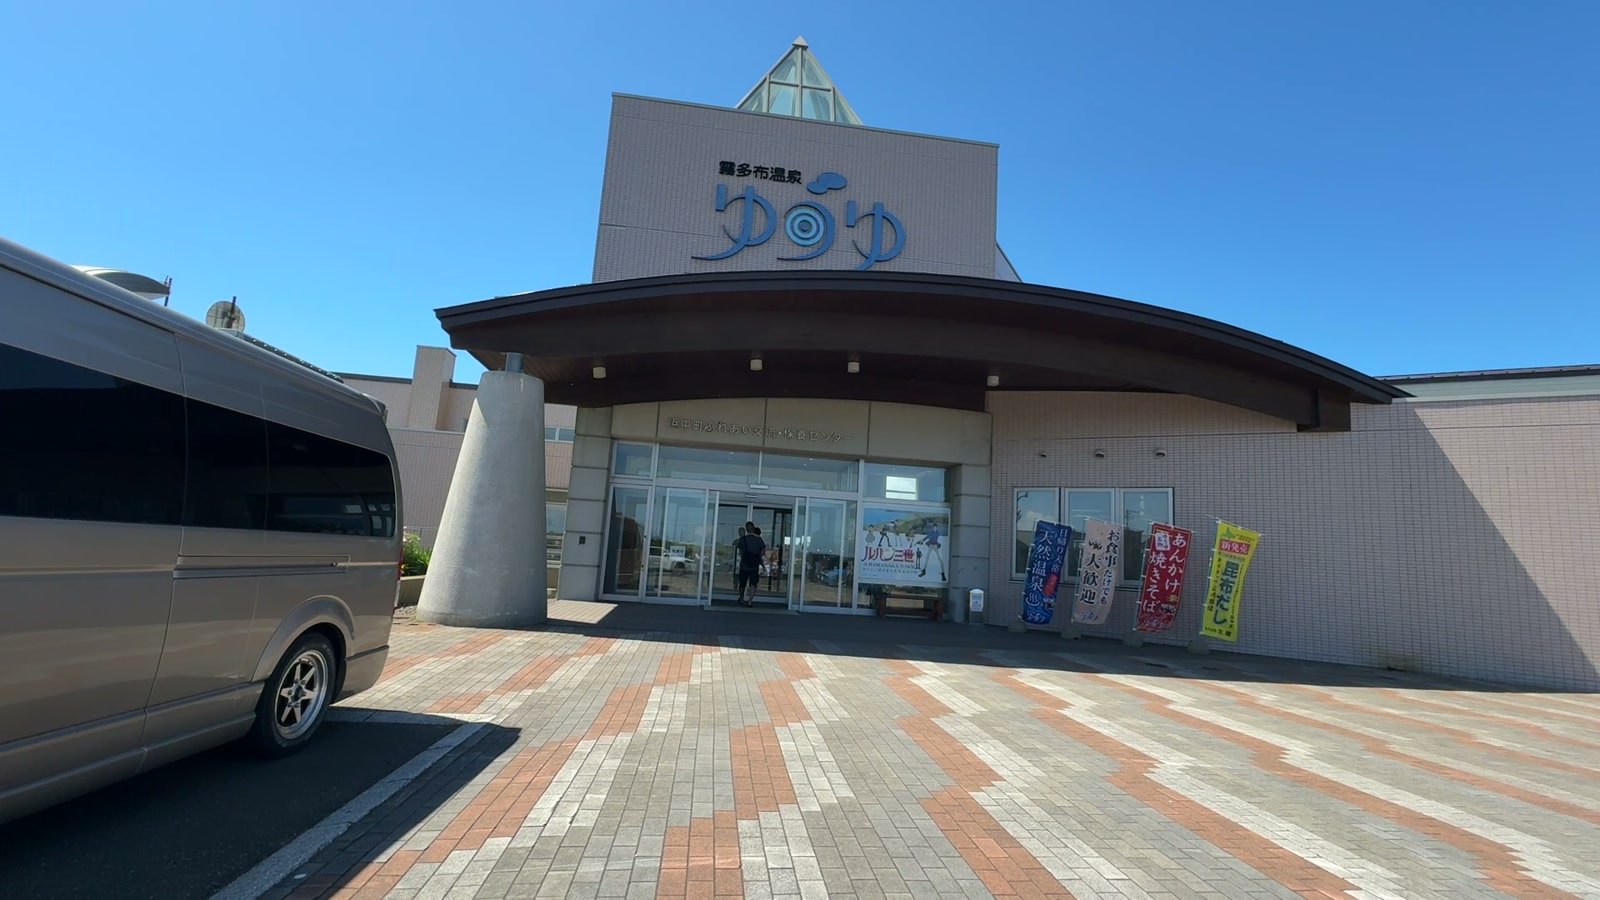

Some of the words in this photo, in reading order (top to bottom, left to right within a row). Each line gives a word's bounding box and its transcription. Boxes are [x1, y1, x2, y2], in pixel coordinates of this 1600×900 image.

[718, 160, 803, 185] 霧多布温泉
[861, 545, 915, 563] ルパン三世
[1030, 529, 1053, 592] 天然温泉
[1100, 529, 1120, 605] お食事だけでも
[1164, 533, 1187, 593] あんかけ
[1220, 539, 1249, 554] 新発売
[1142, 551, 1168, 613] 焼きそば
